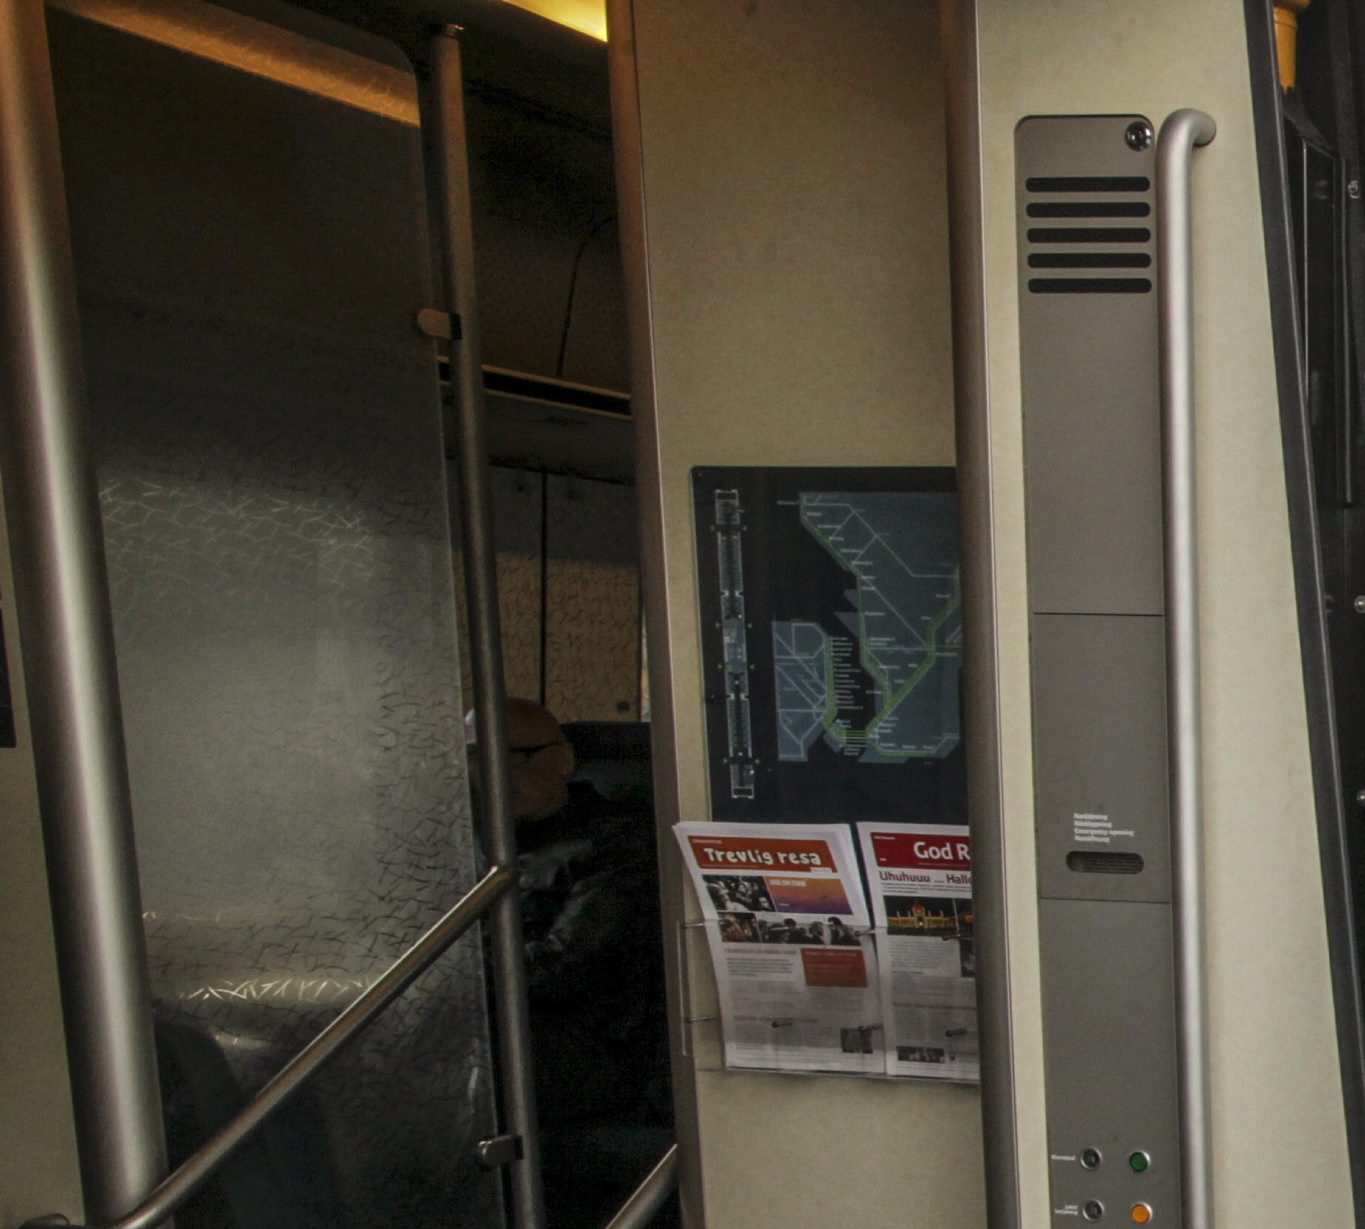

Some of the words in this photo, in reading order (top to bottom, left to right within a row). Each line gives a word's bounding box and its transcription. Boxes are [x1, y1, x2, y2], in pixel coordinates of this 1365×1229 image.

[703, 847, 773, 865] Trevlig
[777, 851, 822, 865] resa
[913, 841, 953, 860] God
